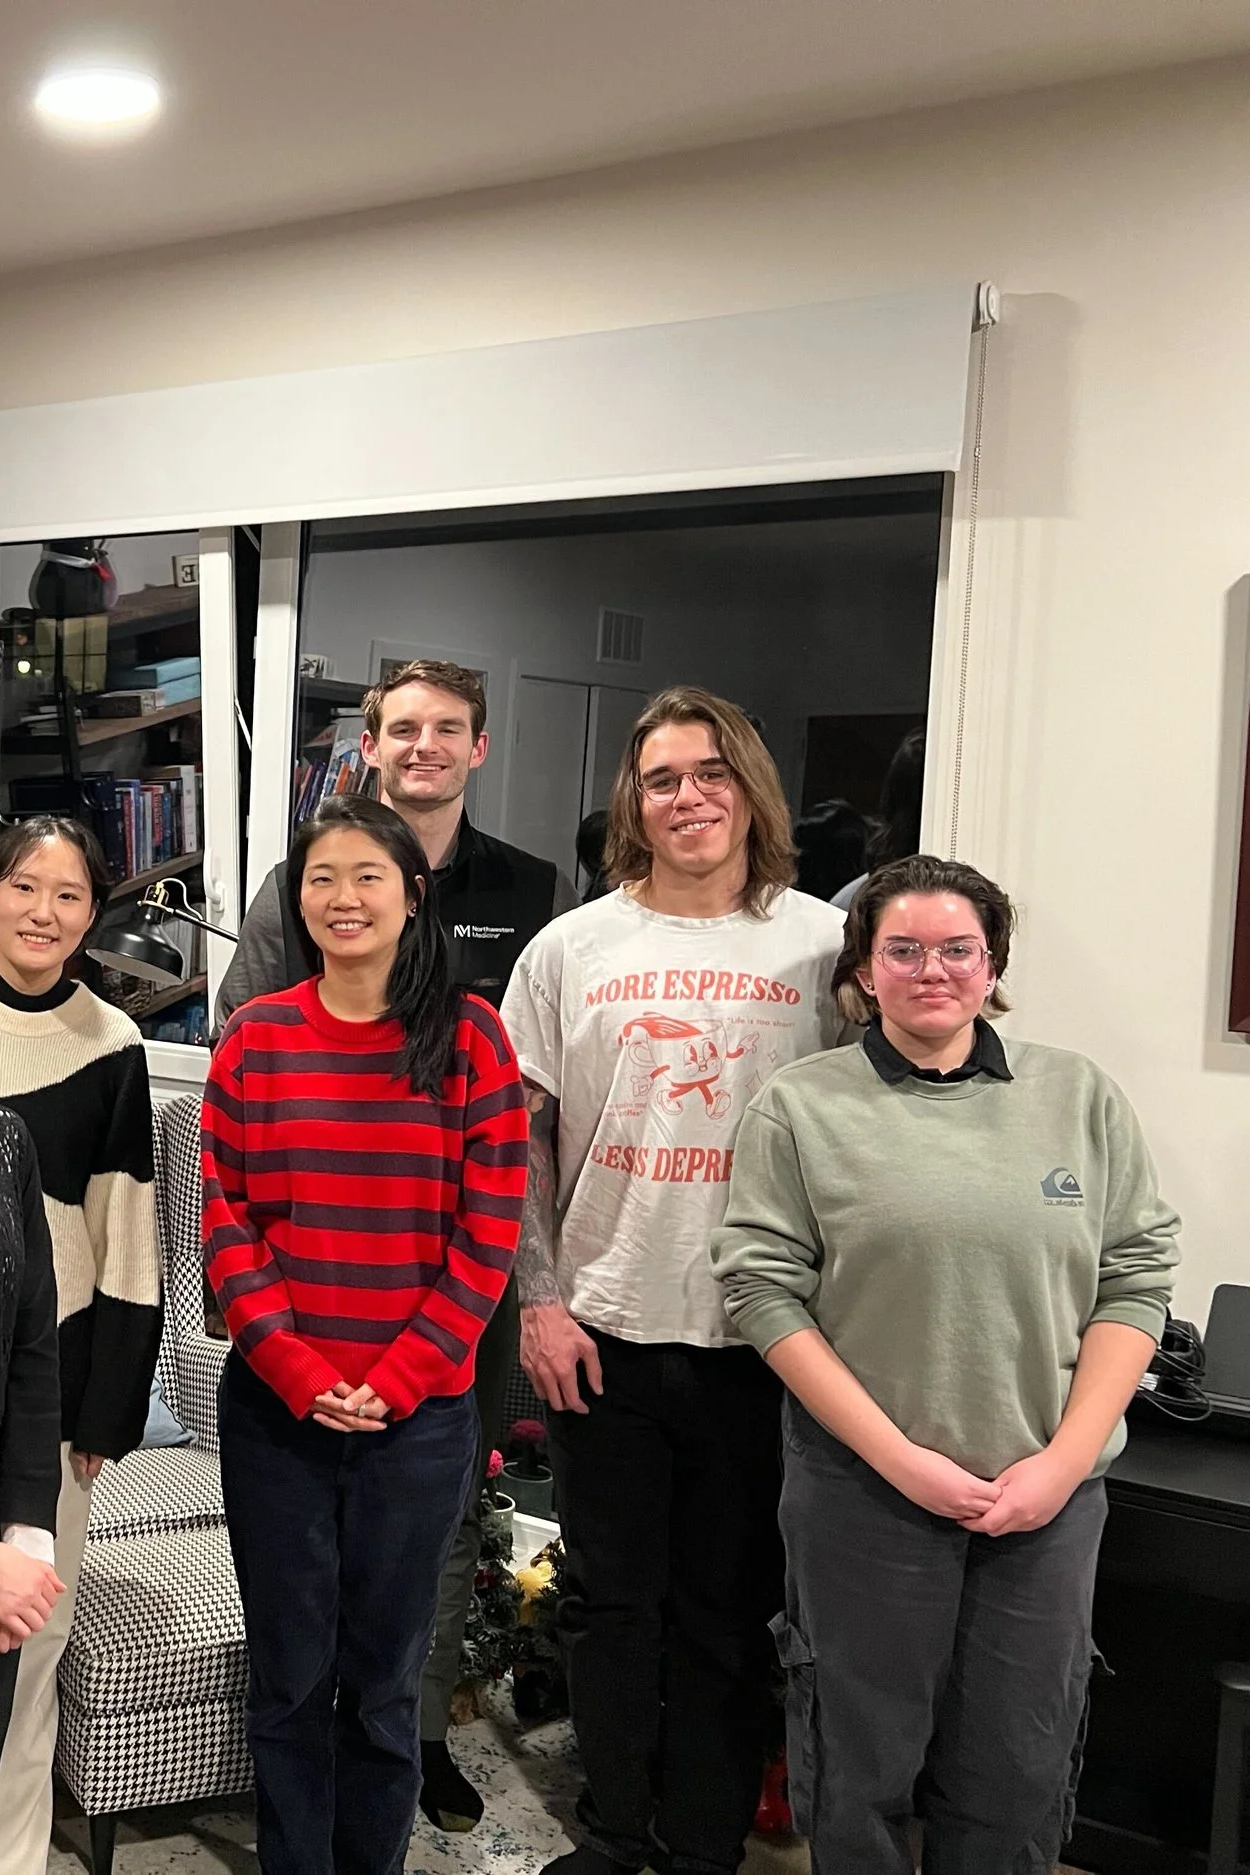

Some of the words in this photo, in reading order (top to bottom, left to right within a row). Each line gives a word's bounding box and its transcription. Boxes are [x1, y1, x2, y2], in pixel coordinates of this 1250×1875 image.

[472, 925, 515, 933] Northwestern
[584, 971, 657, 1008] MORE
[661, 969, 801, 1005] ESPRESSO
[590, 1143, 649, 1178] LESS
